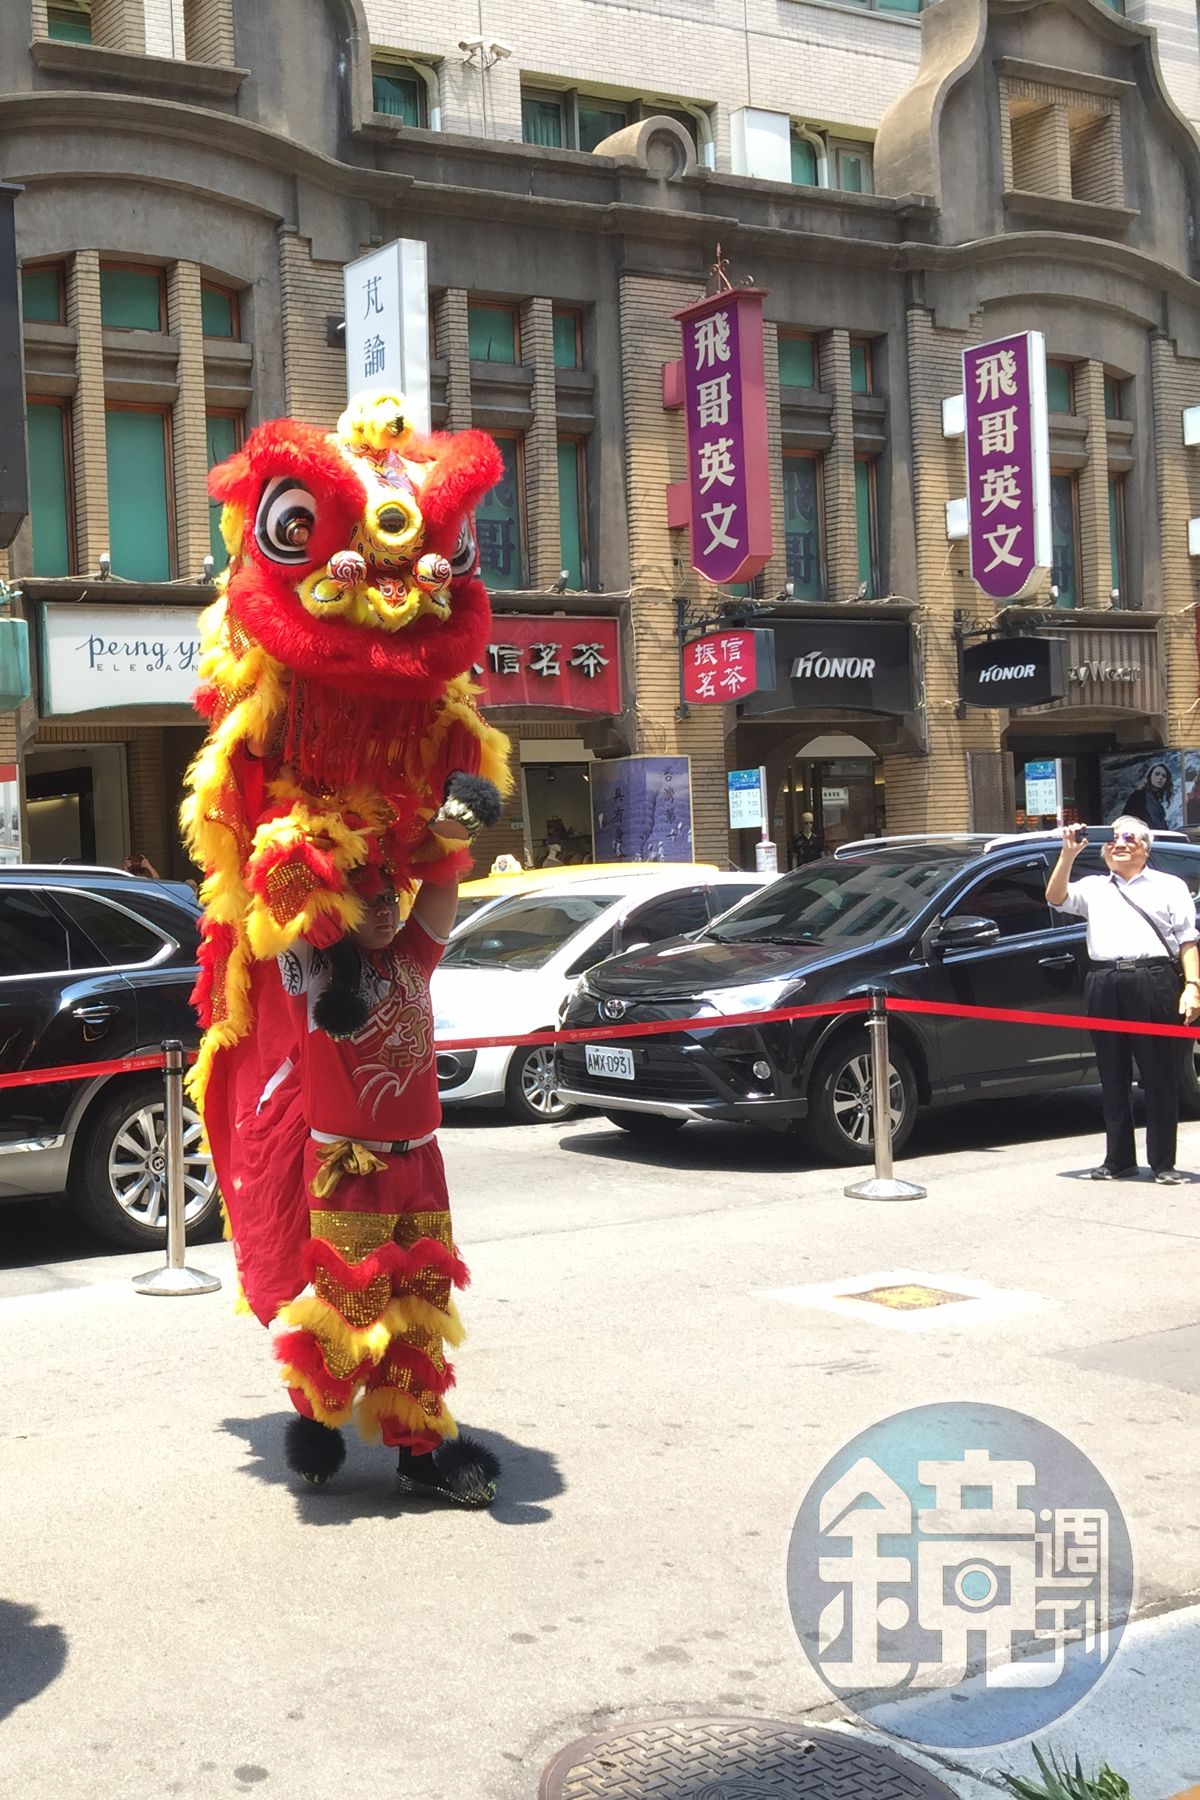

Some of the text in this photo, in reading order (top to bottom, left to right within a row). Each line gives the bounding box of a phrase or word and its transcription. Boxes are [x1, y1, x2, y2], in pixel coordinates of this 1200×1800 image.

[694, 311, 740, 557] 飛哥英文
[975, 349, 1024, 573] 飛哥英文
[96, 663, 199, 672] ELEGAN
[473, 642, 610, 678] 信茗茶
[792, 650, 876, 679] HONOR
[978, 663, 1037, 684] HONOR
[1067, 659, 1141, 688] eyWear
[695, 665, 748, 698] 茗茶
